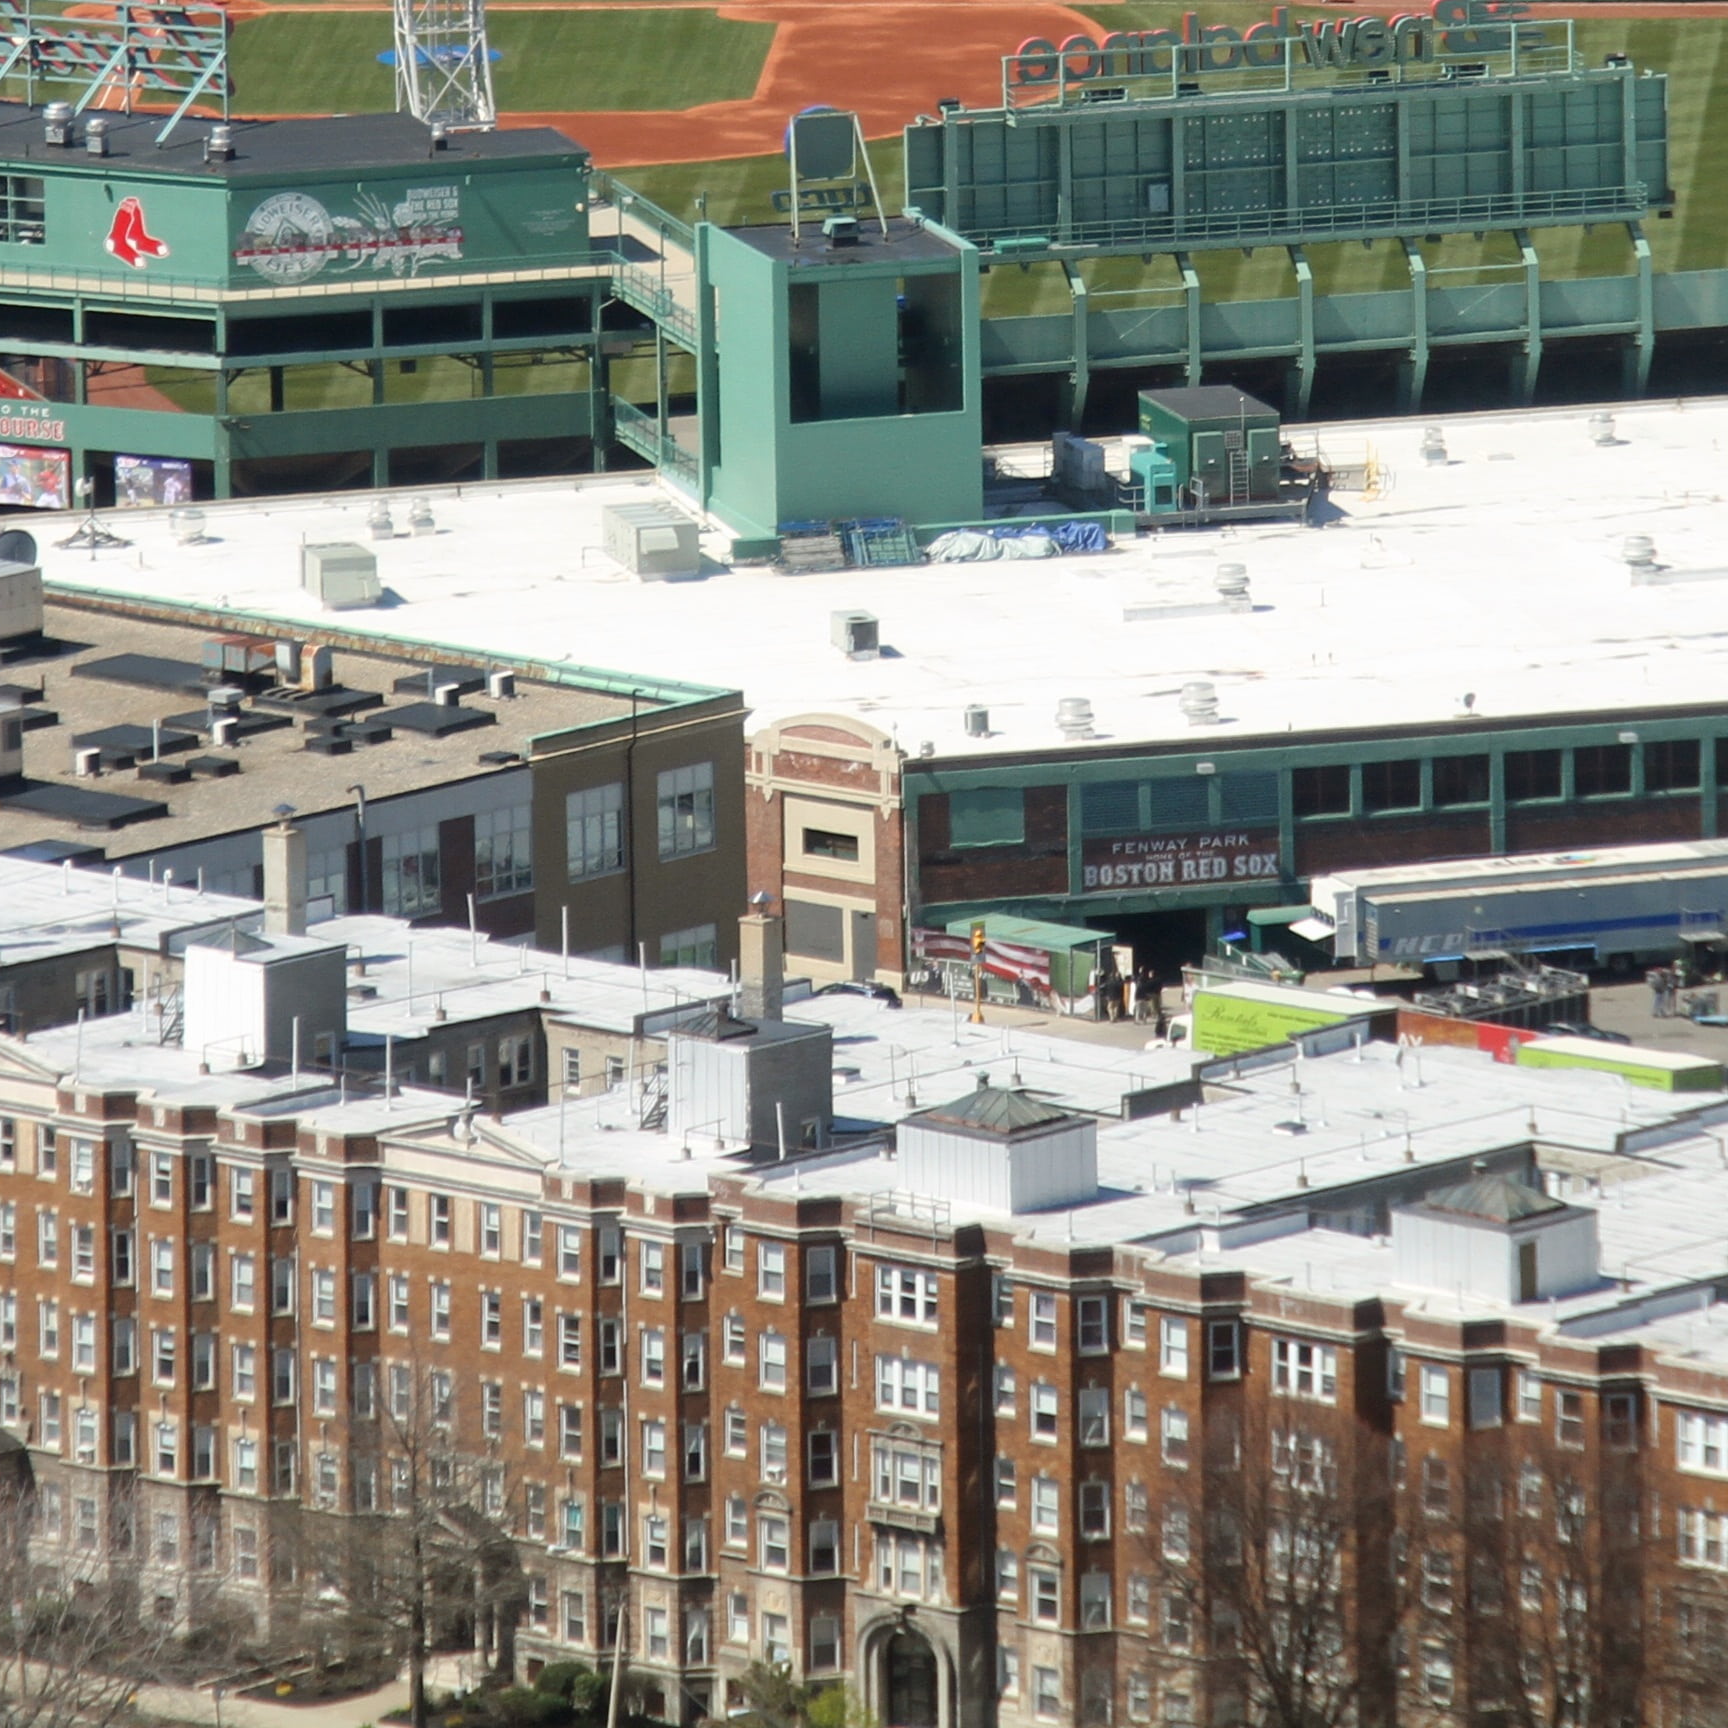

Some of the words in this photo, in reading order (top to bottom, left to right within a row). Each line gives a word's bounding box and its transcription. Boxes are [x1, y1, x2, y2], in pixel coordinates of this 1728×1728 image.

[21, 406, 50, 418] THE
[1112, 837, 1188, 855] FENWAY
[1199, 834, 1249, 849] PARK
[1145, 852, 1172, 861] HOME
[1178, 851, 1191, 860] OF
[1196, 850, 1215, 859] THE
[1084, 860, 1176, 887] BOSTON
[1181, 856, 1228, 882] RED
[1233, 852, 1279, 877] SOX
